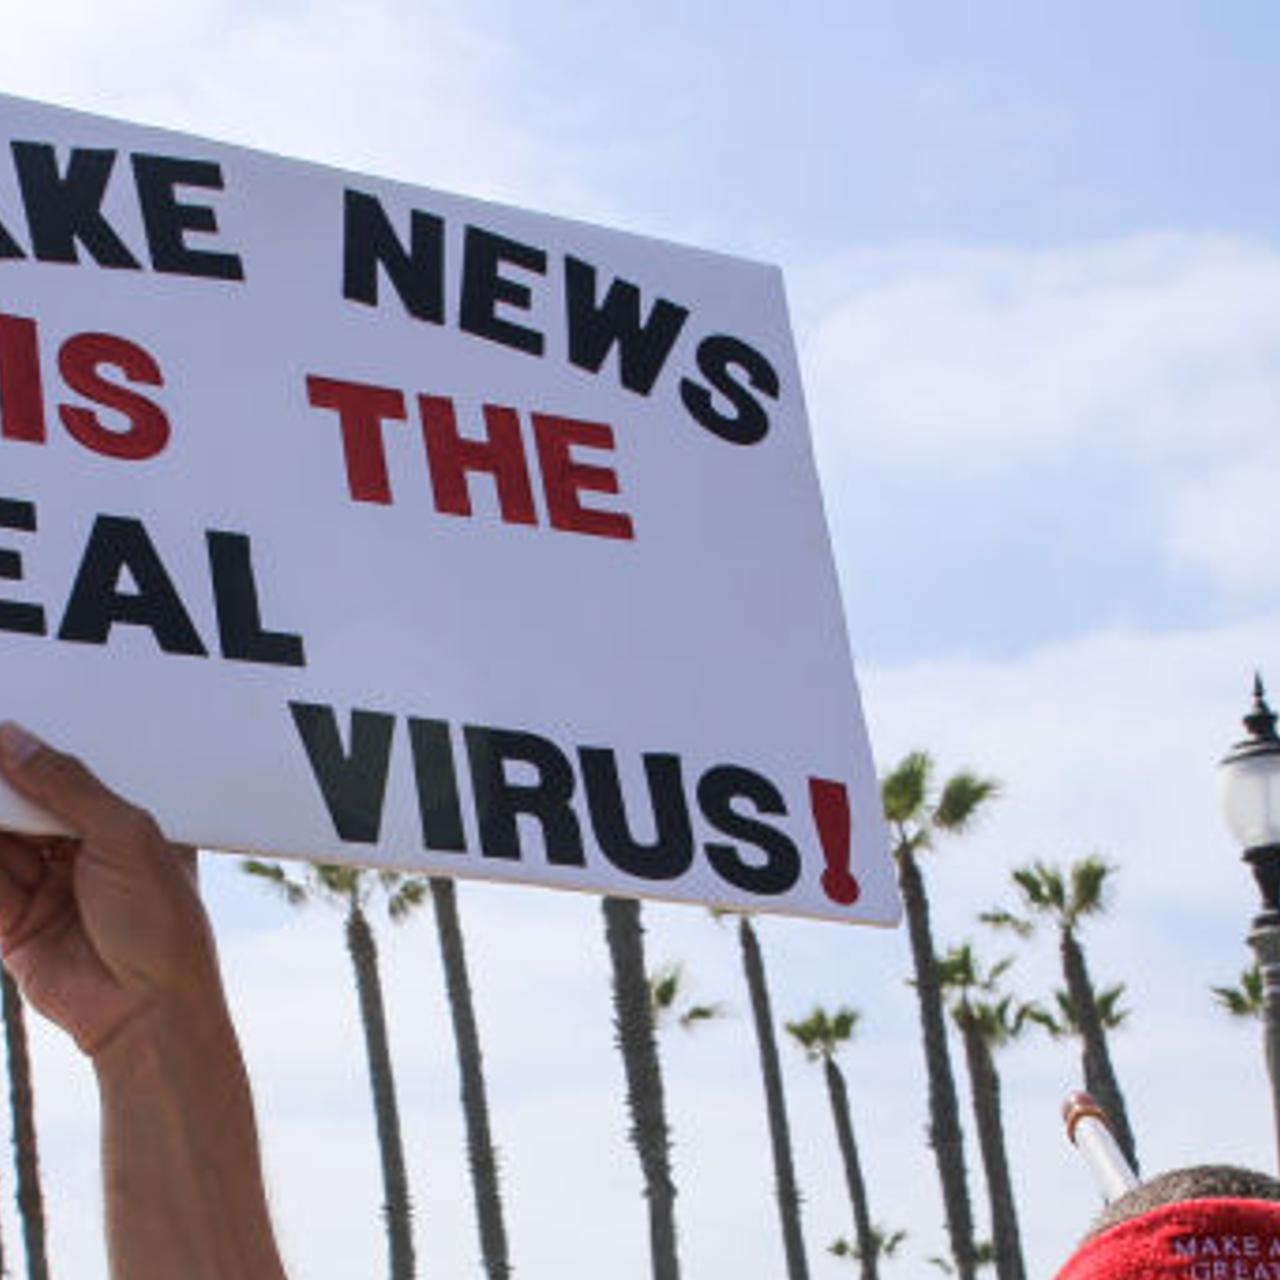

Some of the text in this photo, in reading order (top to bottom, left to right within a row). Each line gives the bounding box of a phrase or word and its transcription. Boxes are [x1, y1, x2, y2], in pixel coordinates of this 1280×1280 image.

[341, 187, 781, 447] NEWS
[305, 373, 636, 541] THE
[287, 700, 861, 907] VIRUS!
[1174, 1236, 1260, 1257] MAKE
